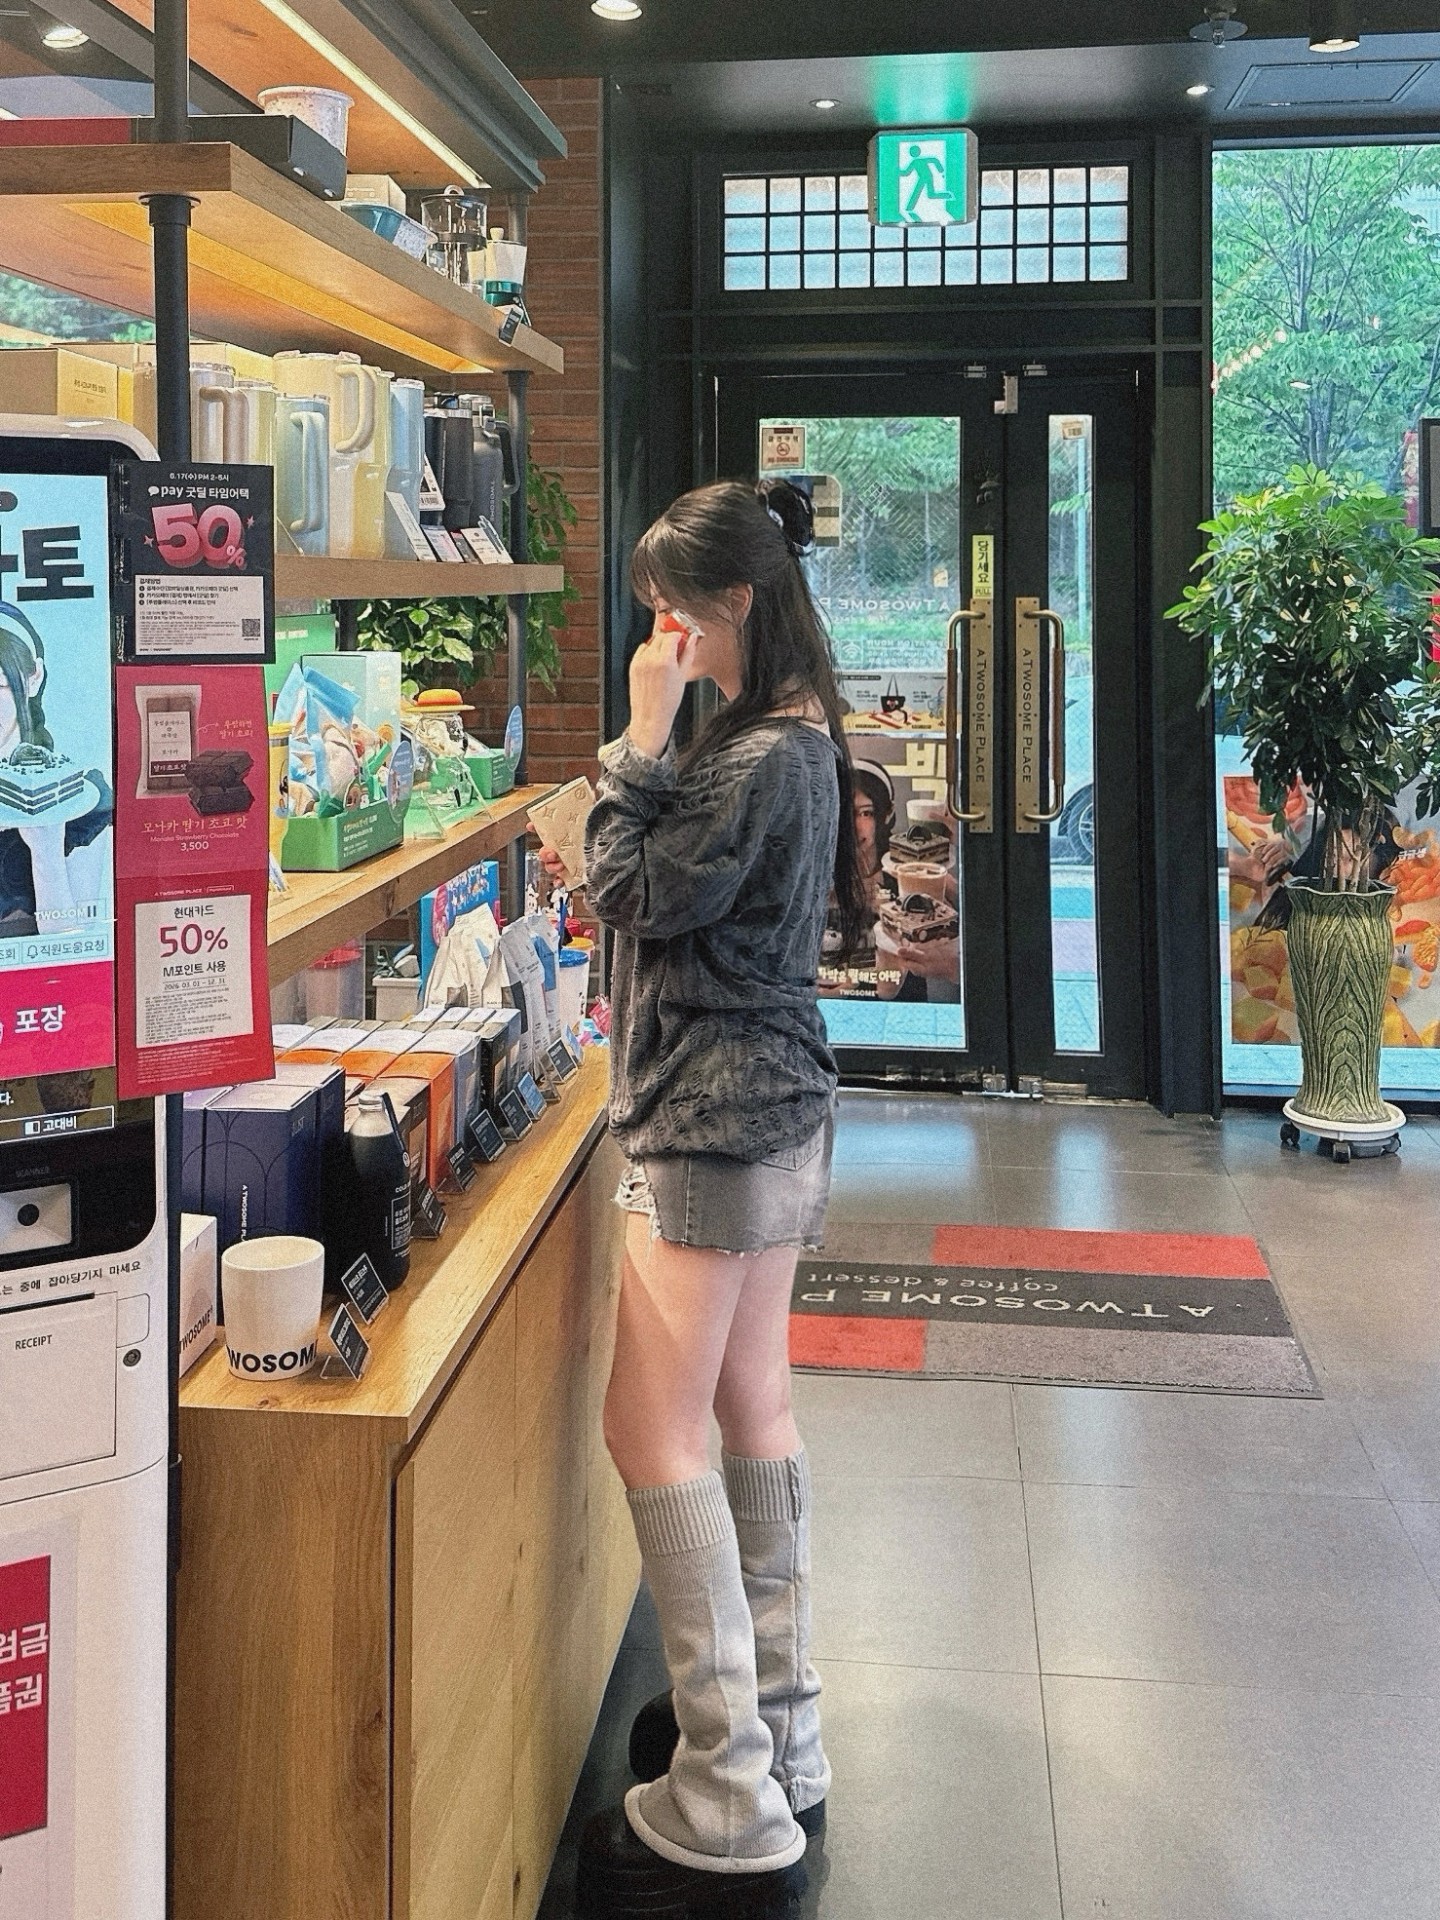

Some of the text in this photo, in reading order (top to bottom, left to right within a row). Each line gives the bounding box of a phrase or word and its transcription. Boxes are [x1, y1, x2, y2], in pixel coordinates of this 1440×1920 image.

[161, 486, 250, 500] pay 굿딜 타임어택
[152, 503, 247, 570] 50%
[978, 541, 989, 583] 당기세요
[975, 648, 986, 782] A TWOSOME PLACE
[1023, 648, 1033, 783] A TWOSOME PLACE
[141, 820, 179, 833] 모나카
[182, 818, 206, 833] 딸기
[236, 816, 248, 829] 맛
[180, 841, 210, 852] 3,500
[34, 908, 88, 922] TWOSOM
[174, 905, 215, 919] 현대카드
[40, 939, 105, 957] 직원도움요청
[160, 923, 229, 958] 50%
[163, 961, 226, 977] M포인트 사용
[840, 989, 876, 997] TWOSOME
[15, 1005, 66, 1034] 포장
[43, 1116, 77, 1132] 고대비
[20, 1279, 41, 1292] 중에
[49, 1268, 103, 1287] 잡아당기지
[109, 1261, 141, 1275] 마세요
[808, 1273, 923, 1288] dessert
[960, 1277, 1058, 1293] coffee
[862, 1289, 1169, 1318] TWOSOME
[1178, 1304, 1214, 1318] A
[15, 1335, 52, 1350] RECEIPT
